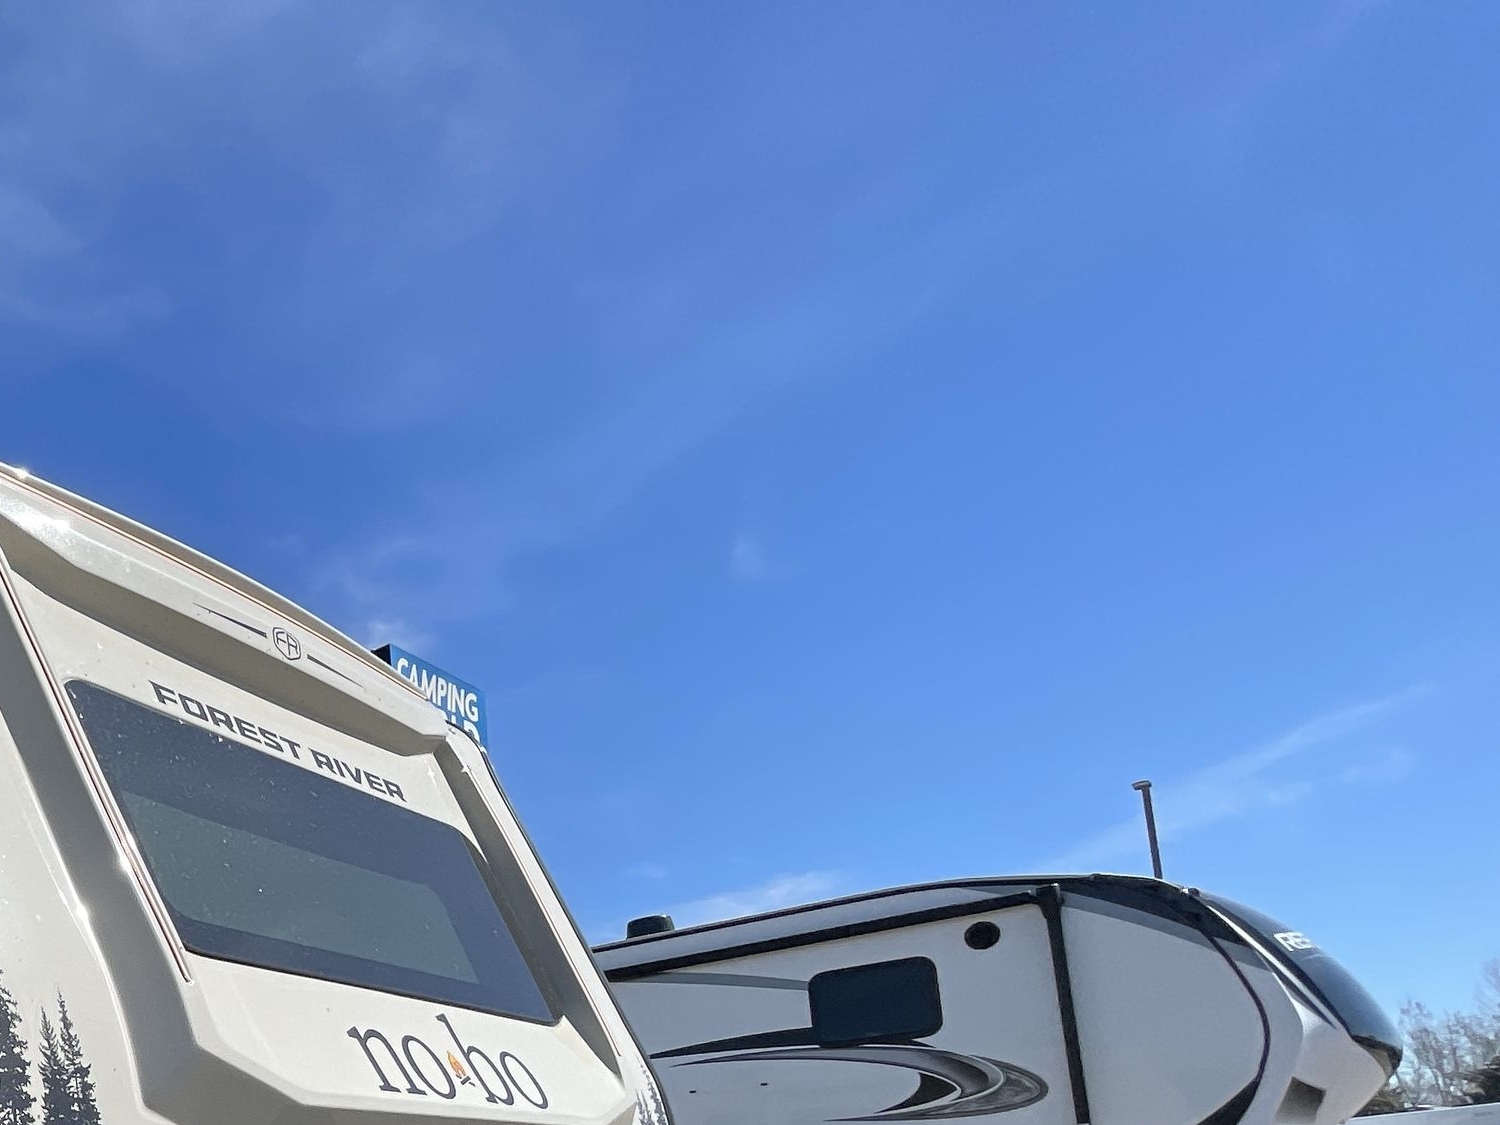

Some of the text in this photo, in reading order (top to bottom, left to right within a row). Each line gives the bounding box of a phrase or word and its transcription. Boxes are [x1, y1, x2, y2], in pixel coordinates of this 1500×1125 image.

[397, 657, 479, 722] CAMPING
[148, 679, 406, 802] FOREST RIVER
